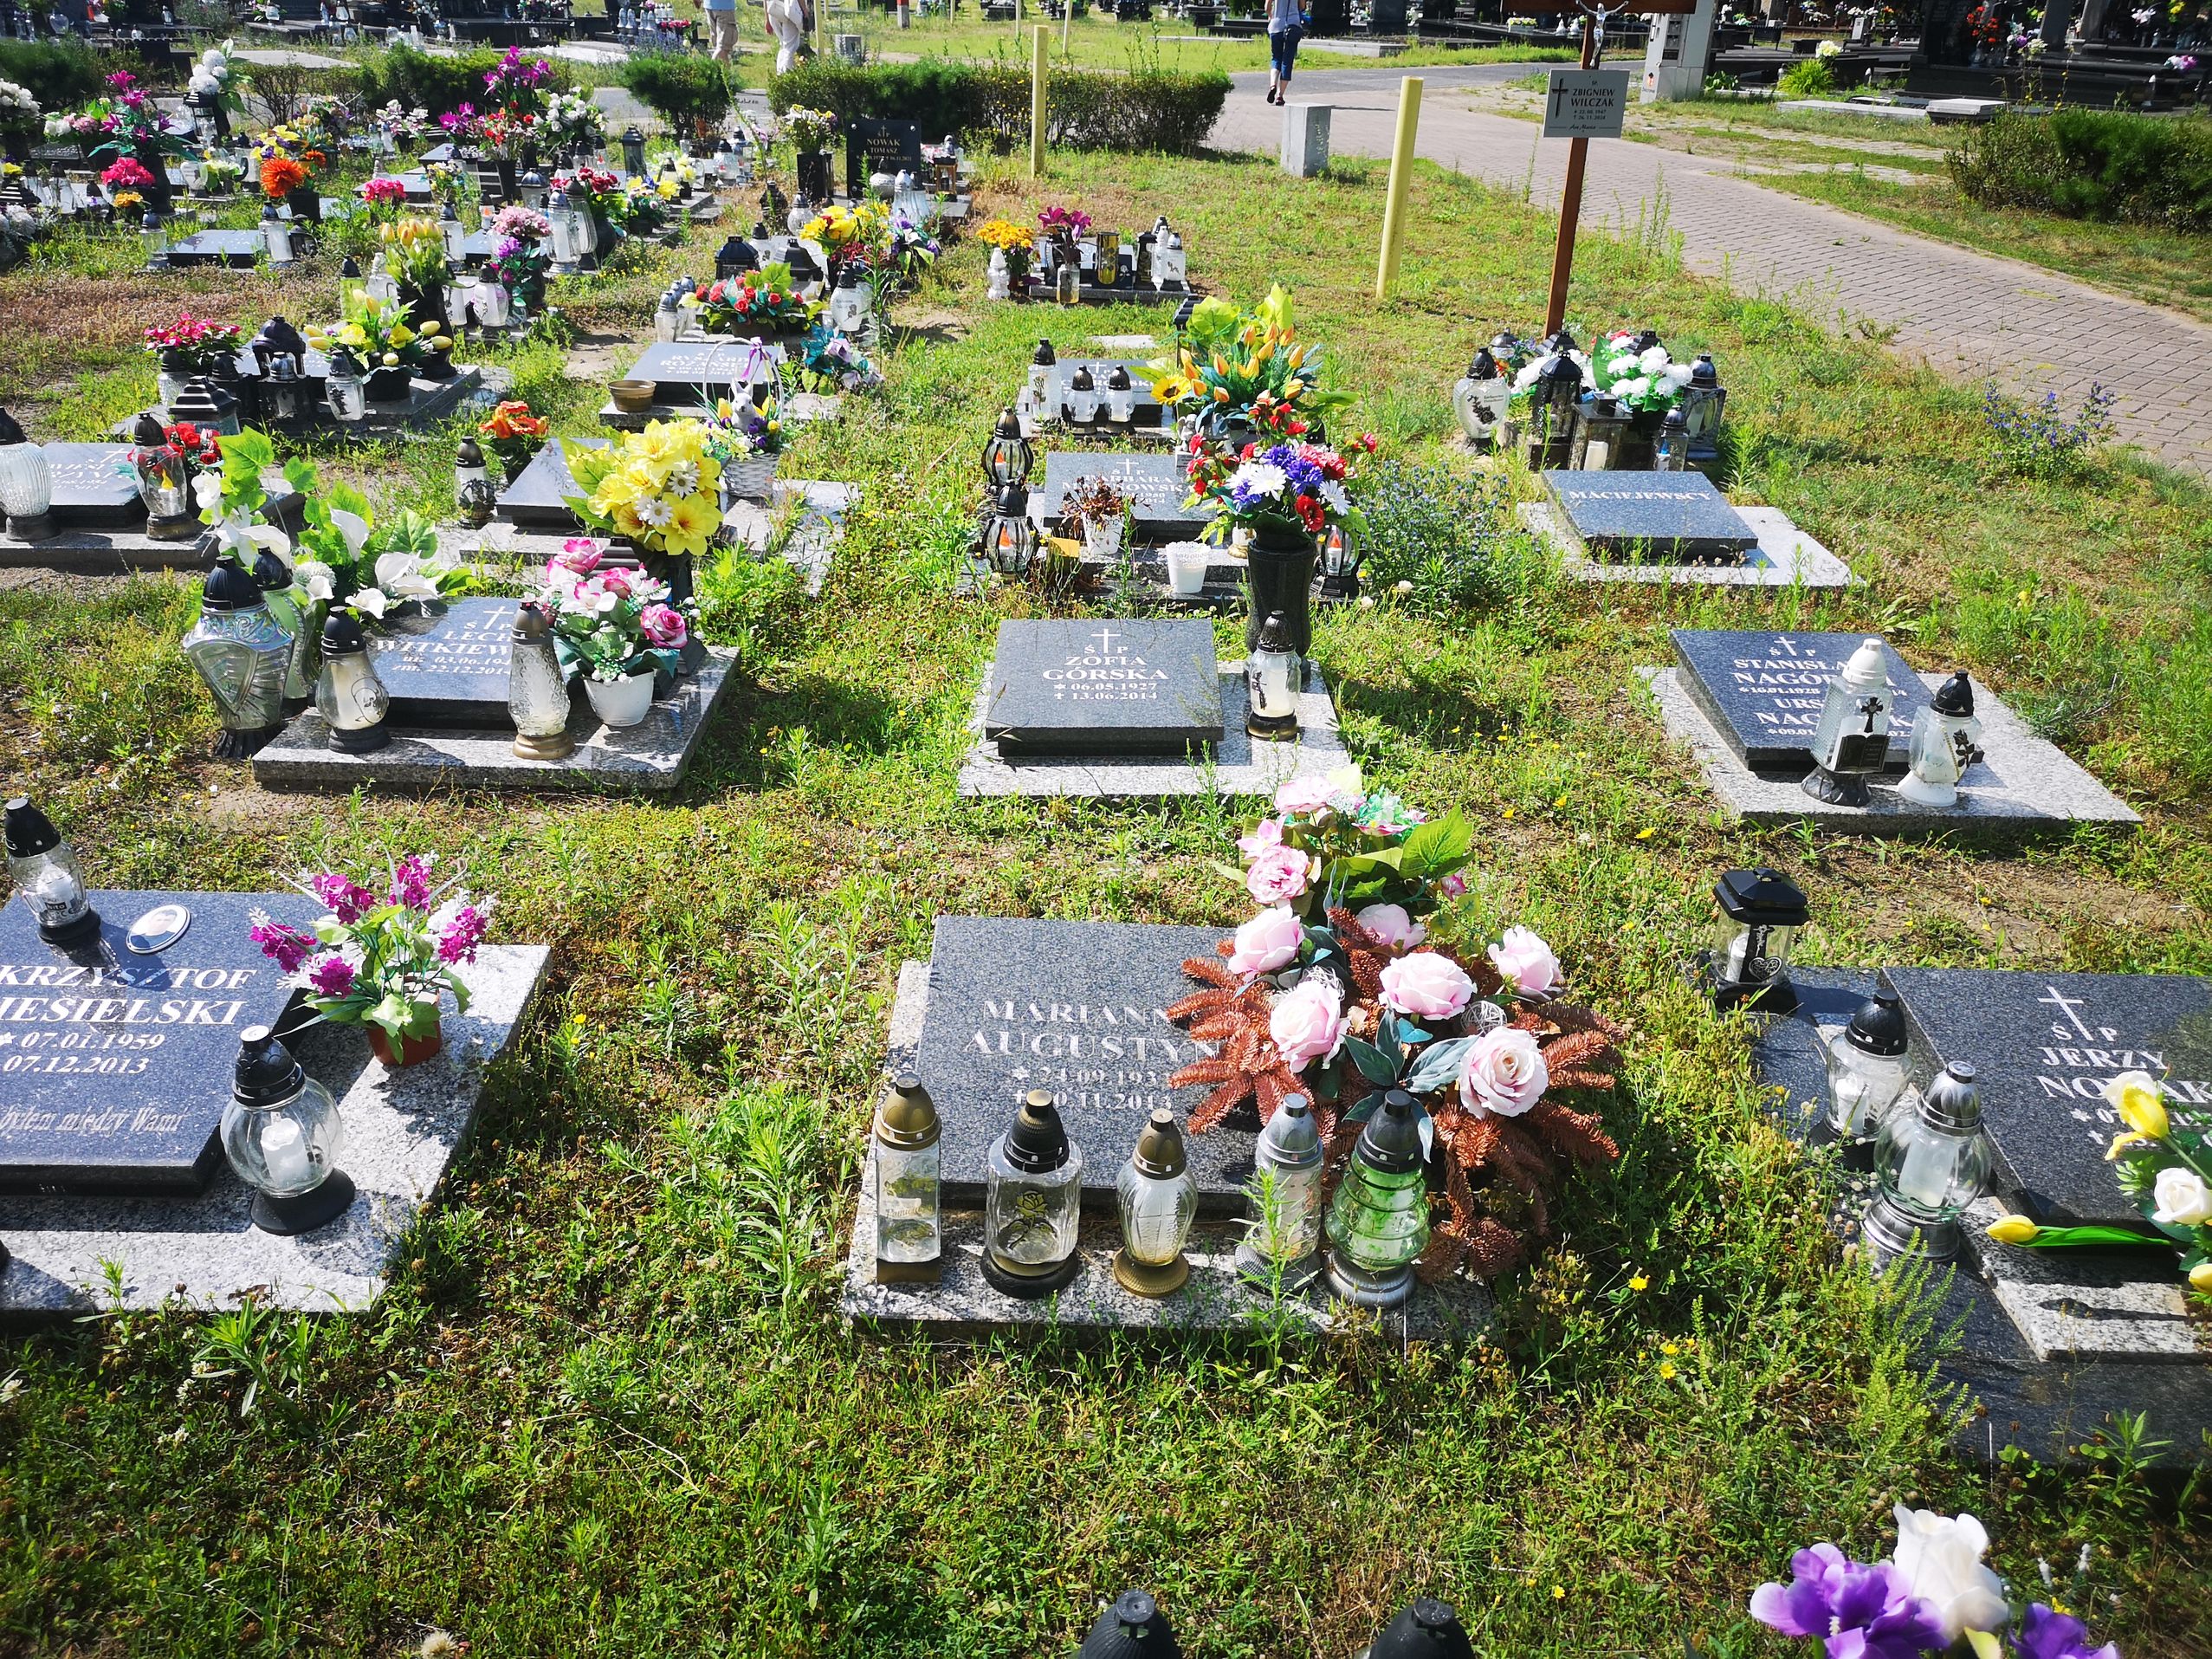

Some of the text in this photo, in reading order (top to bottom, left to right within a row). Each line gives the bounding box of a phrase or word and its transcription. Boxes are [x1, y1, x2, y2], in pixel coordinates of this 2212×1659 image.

[1572, 88, 1615, 97] ZBIGNIEW
[1570, 98, 1614, 107] WILCZAK
[1568, 491, 1711, 501] MACIEJEWSCY
[377, 640, 509, 656] WITKIEW
[1083, 644, 1096, 654] Ś
[1064, 656, 1148, 666] ZOFIA
[1733, 658, 1850, 671] STANISŁA
[1042, 666, 1170, 680] GÓRSKA
[0, 965, 258, 989] KRZYSZTOF
[982, 1000, 1171, 1025] MARIANN
[2051, 1021, 2118, 1042] Ś P
[21, 1032, 166, 1050] 07.01.1959
[962, 1028, 1223, 1062] AUGUSTYN
[3, 1055, 151, 1073] 07.12.2013
[2037, 1047, 2170, 1071] JERZY
[1039, 1066, 1172, 1086] 24.09.193
[2035, 1075, 2212, 1104] NOAK
